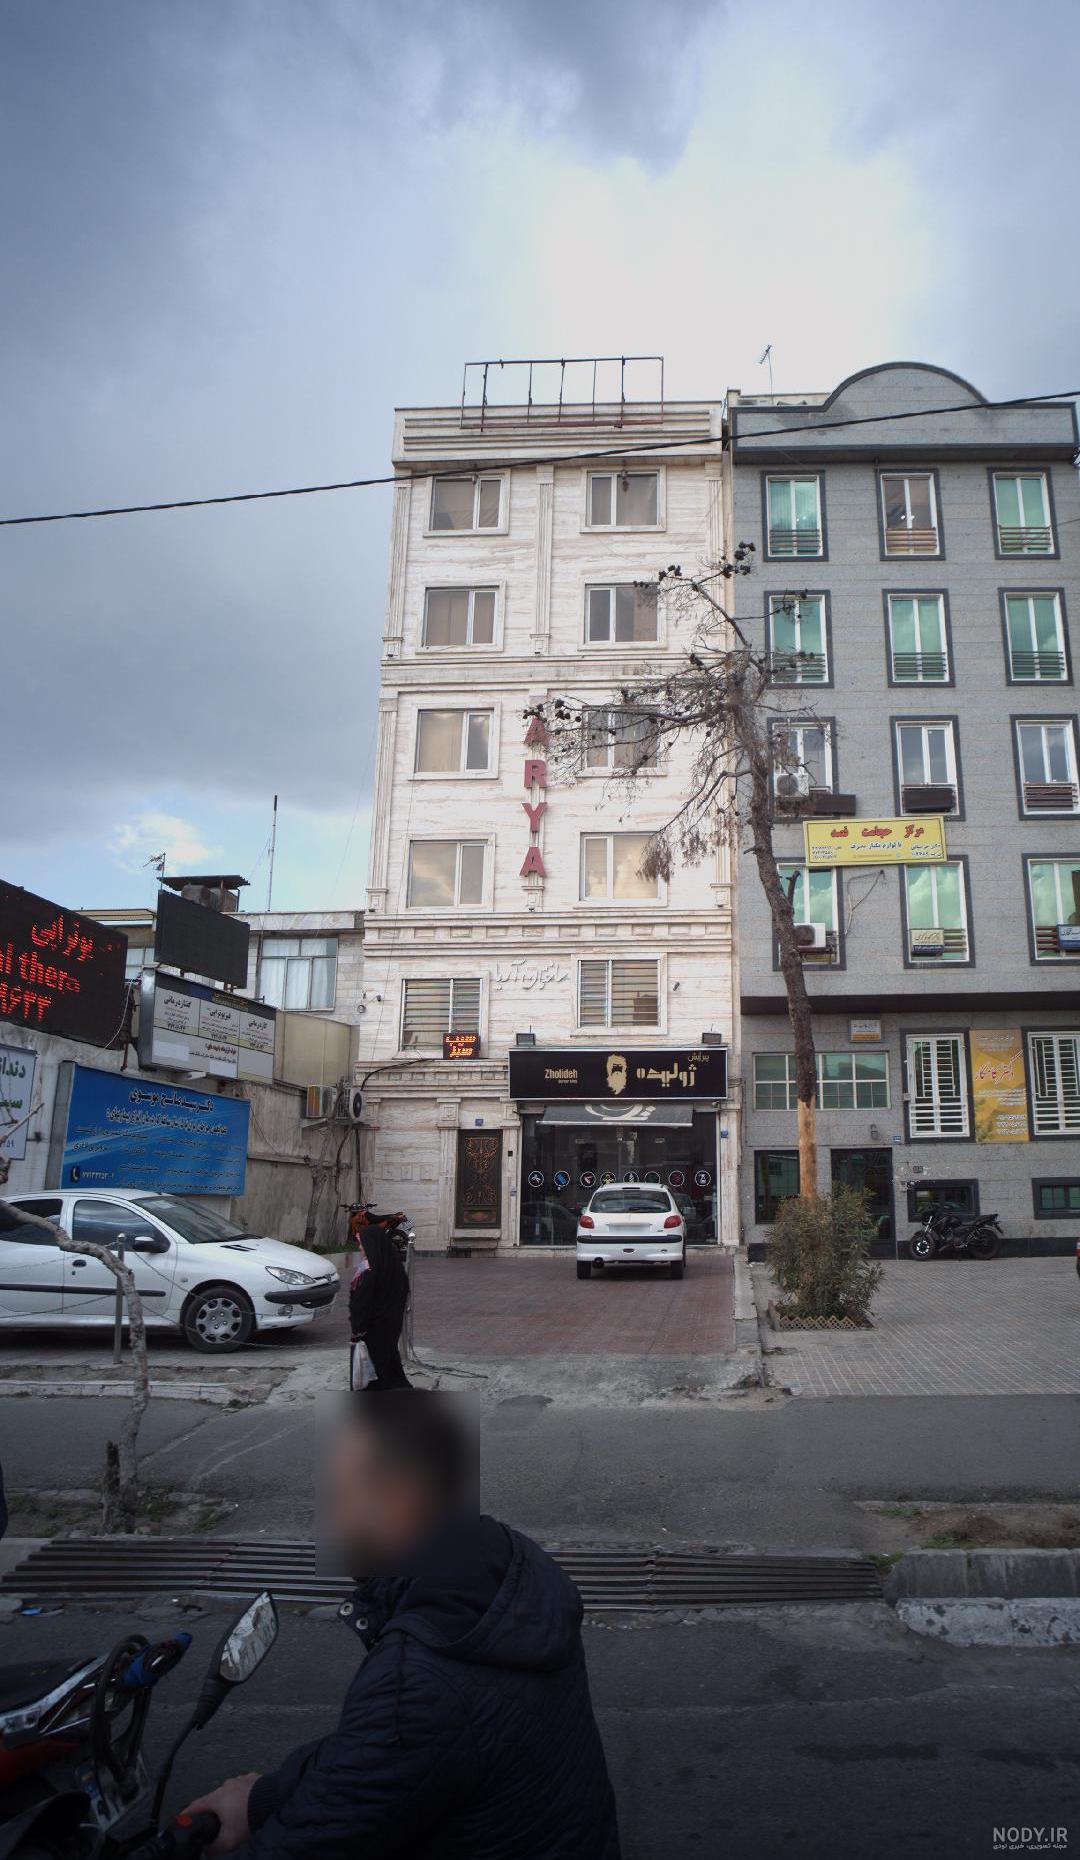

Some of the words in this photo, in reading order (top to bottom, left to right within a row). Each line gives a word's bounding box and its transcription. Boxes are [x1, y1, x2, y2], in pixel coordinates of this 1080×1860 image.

[519, 716, 549, 877] ARYA
[862, 825, 892, 839] حجامت
[904, 824, 925, 838] مرکز
[544, 1068, 578, 1079] Zholideh
[636, 1063, 697, 1087] ژولیده
